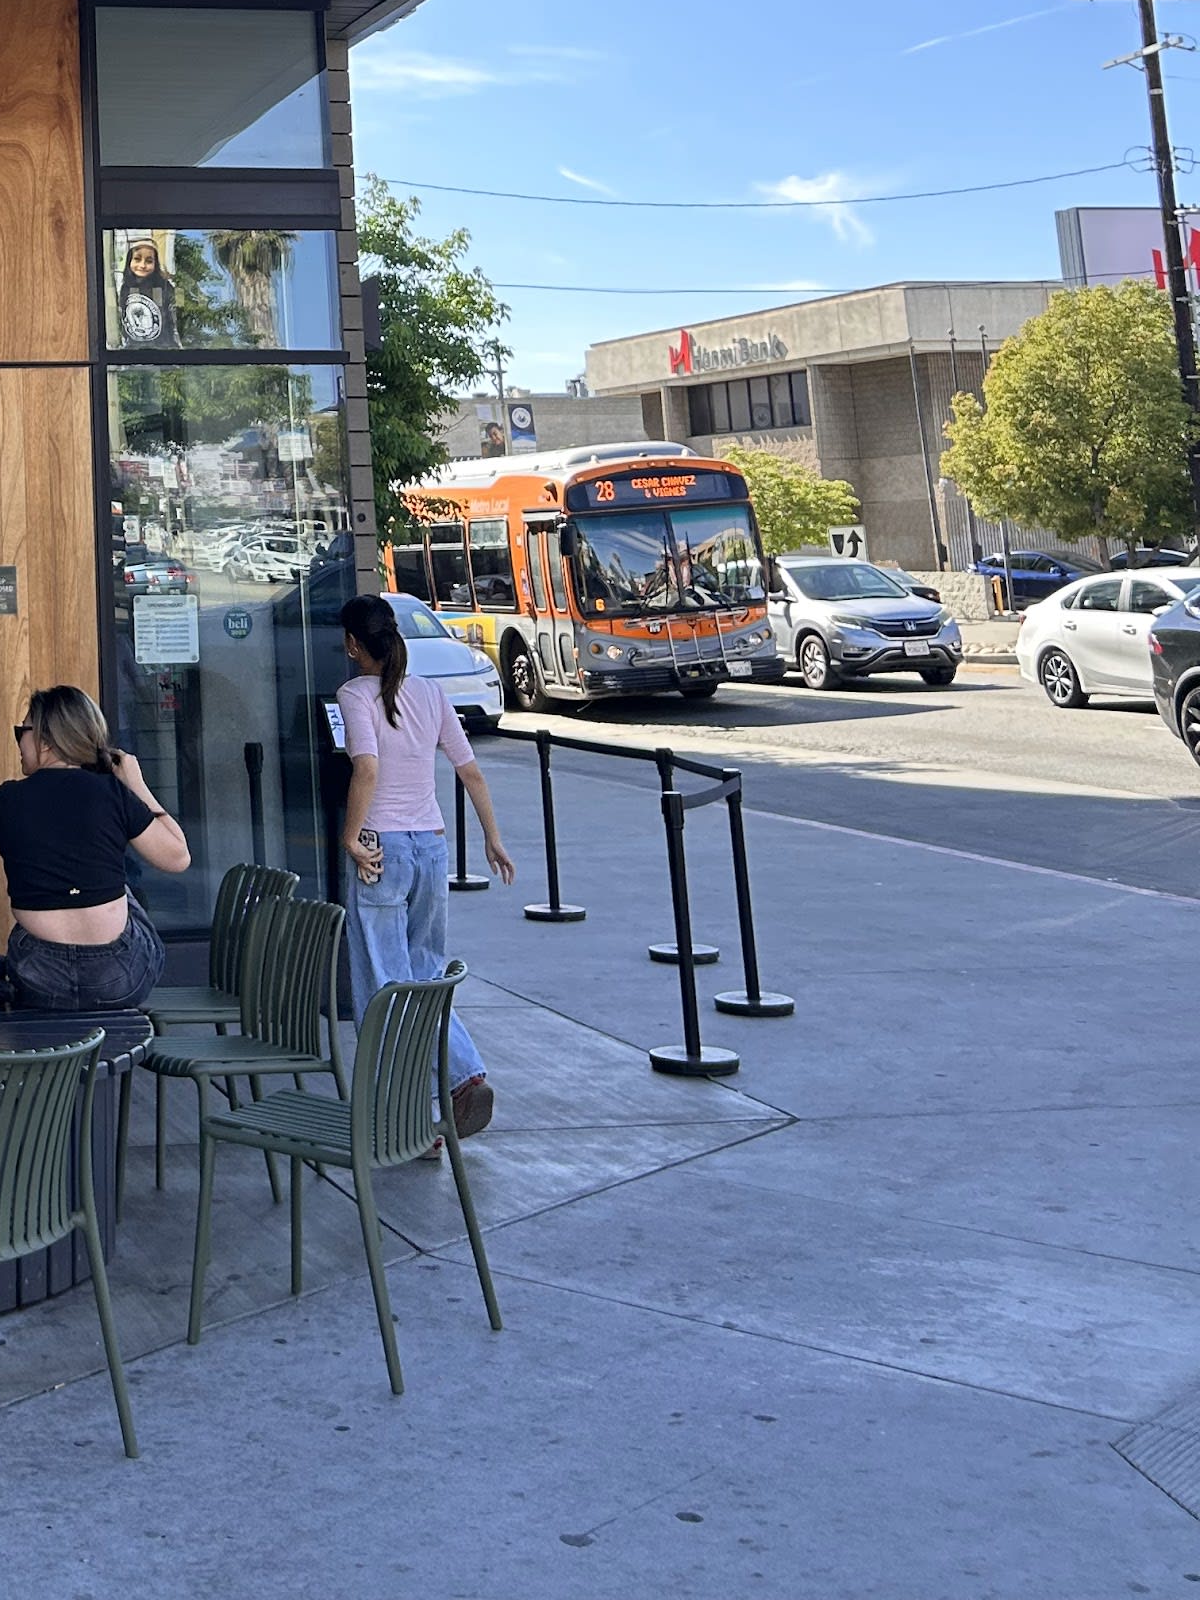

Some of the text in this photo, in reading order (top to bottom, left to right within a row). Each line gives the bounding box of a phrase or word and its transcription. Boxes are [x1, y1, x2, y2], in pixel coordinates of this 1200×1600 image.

[739, 333, 788, 363] Bank
[595, 475, 696, 502] 28 CESAR CHAVEZ
[228, 617, 248, 629] beli
